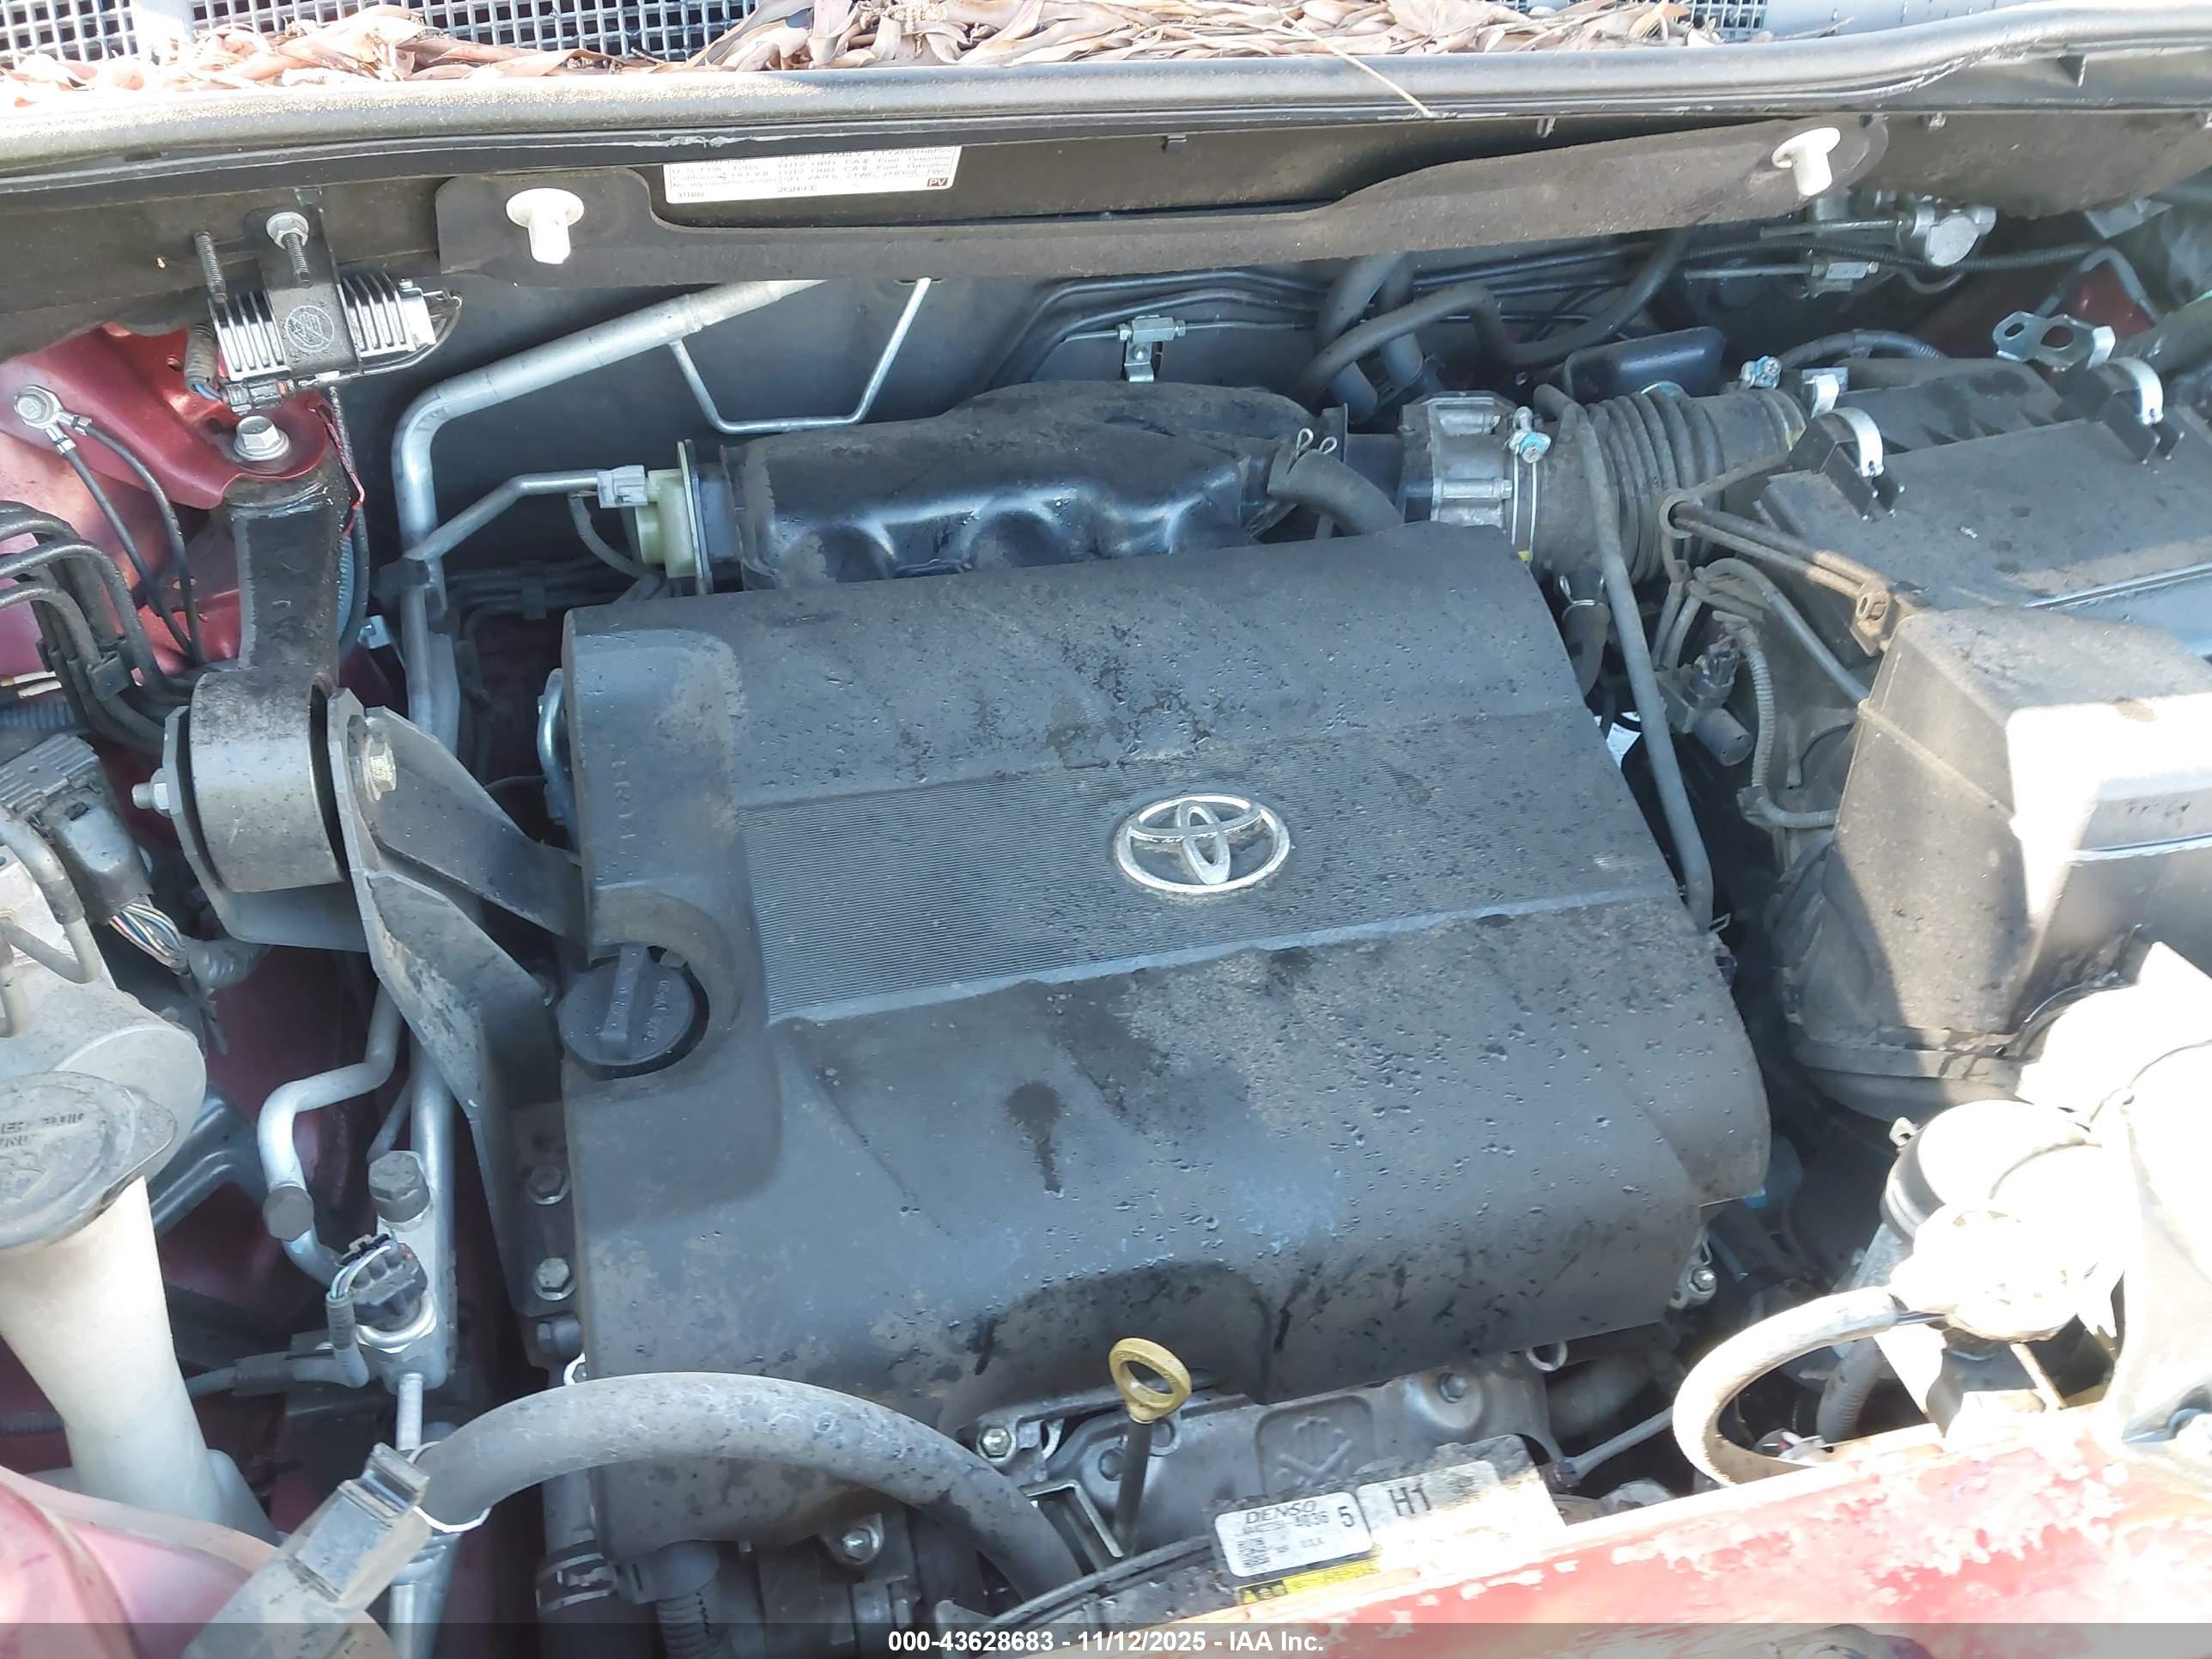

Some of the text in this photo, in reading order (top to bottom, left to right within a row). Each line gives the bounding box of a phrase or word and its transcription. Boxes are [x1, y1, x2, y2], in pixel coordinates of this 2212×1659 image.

[1245, 1500, 1316, 1524] DENSO
[1388, 1484, 1431, 1516] H1
[1337, 1506, 1355, 1528] 5
